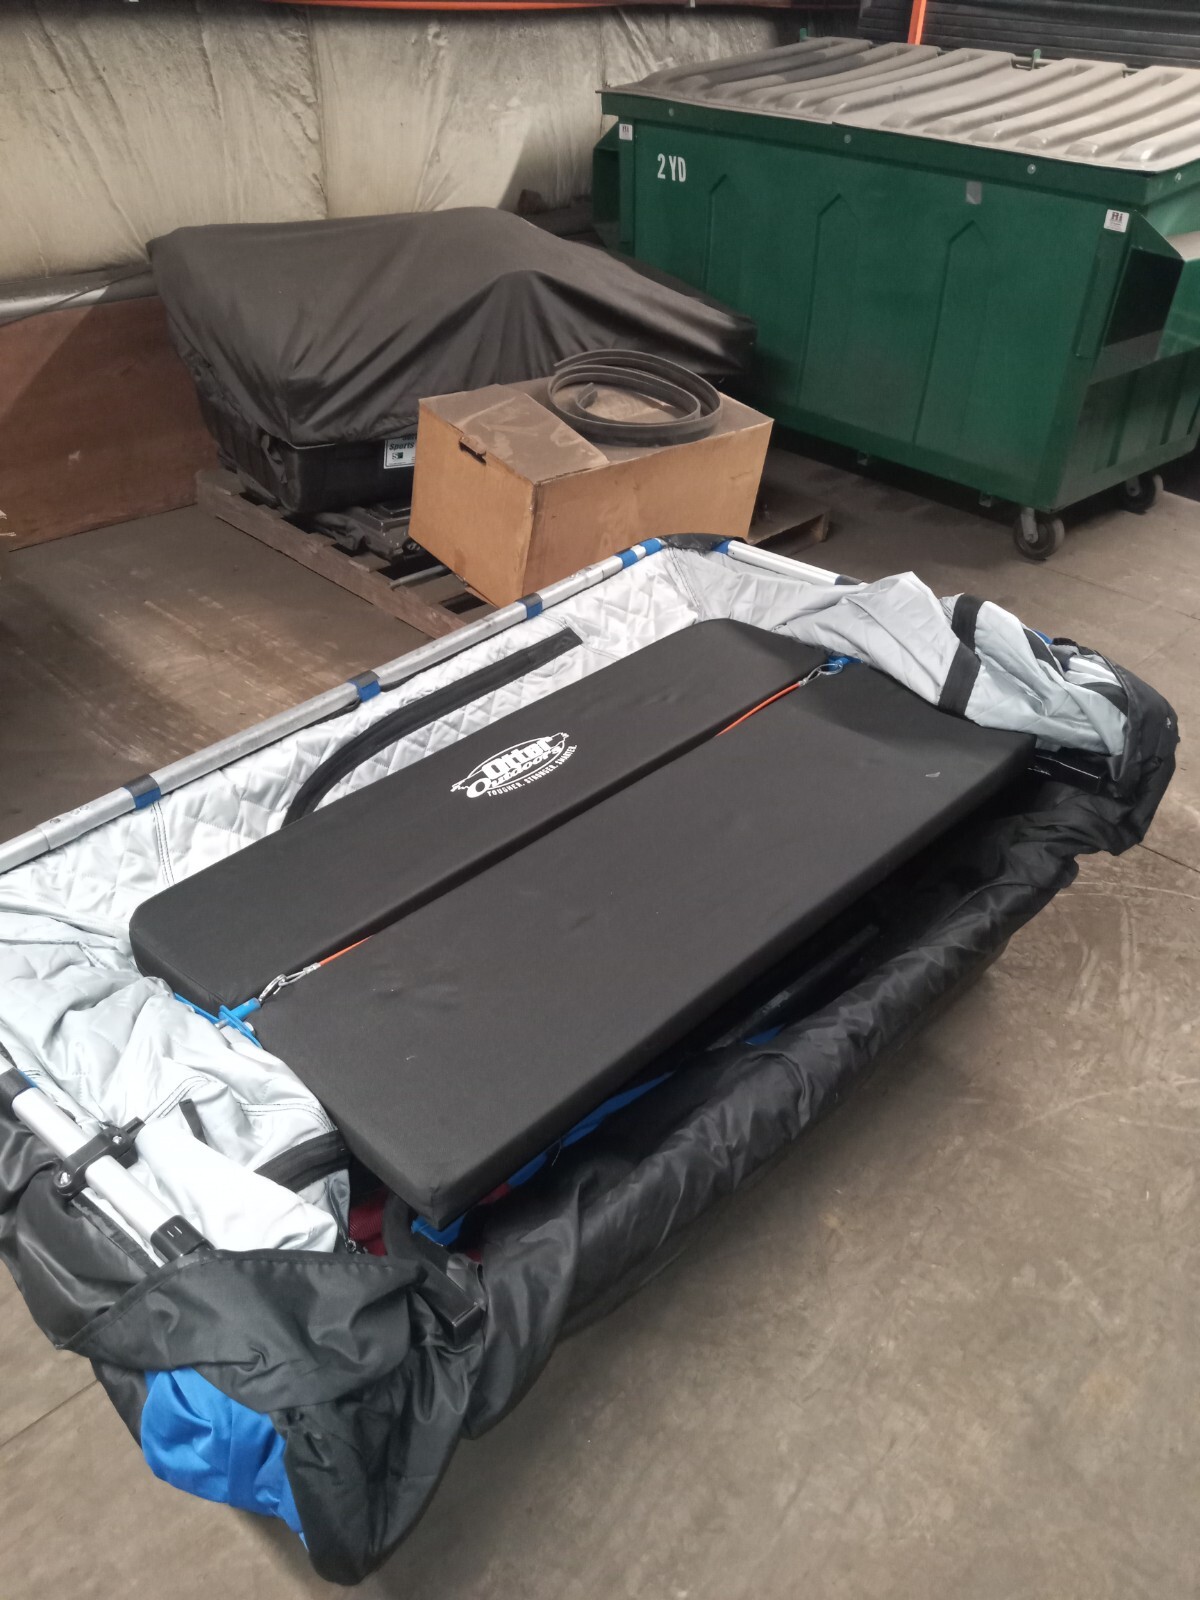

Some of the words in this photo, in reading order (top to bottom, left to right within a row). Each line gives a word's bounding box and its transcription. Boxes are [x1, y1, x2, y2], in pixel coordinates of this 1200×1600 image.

[657, 153, 666, 179] 2
[668, 155, 687, 182] YD
[466, 745, 562, 798] Outdoors
[482, 736, 553, 780] Otter
[486, 782, 526, 797] TOUGHER.
[523, 764, 559, 784] STRONGER.
